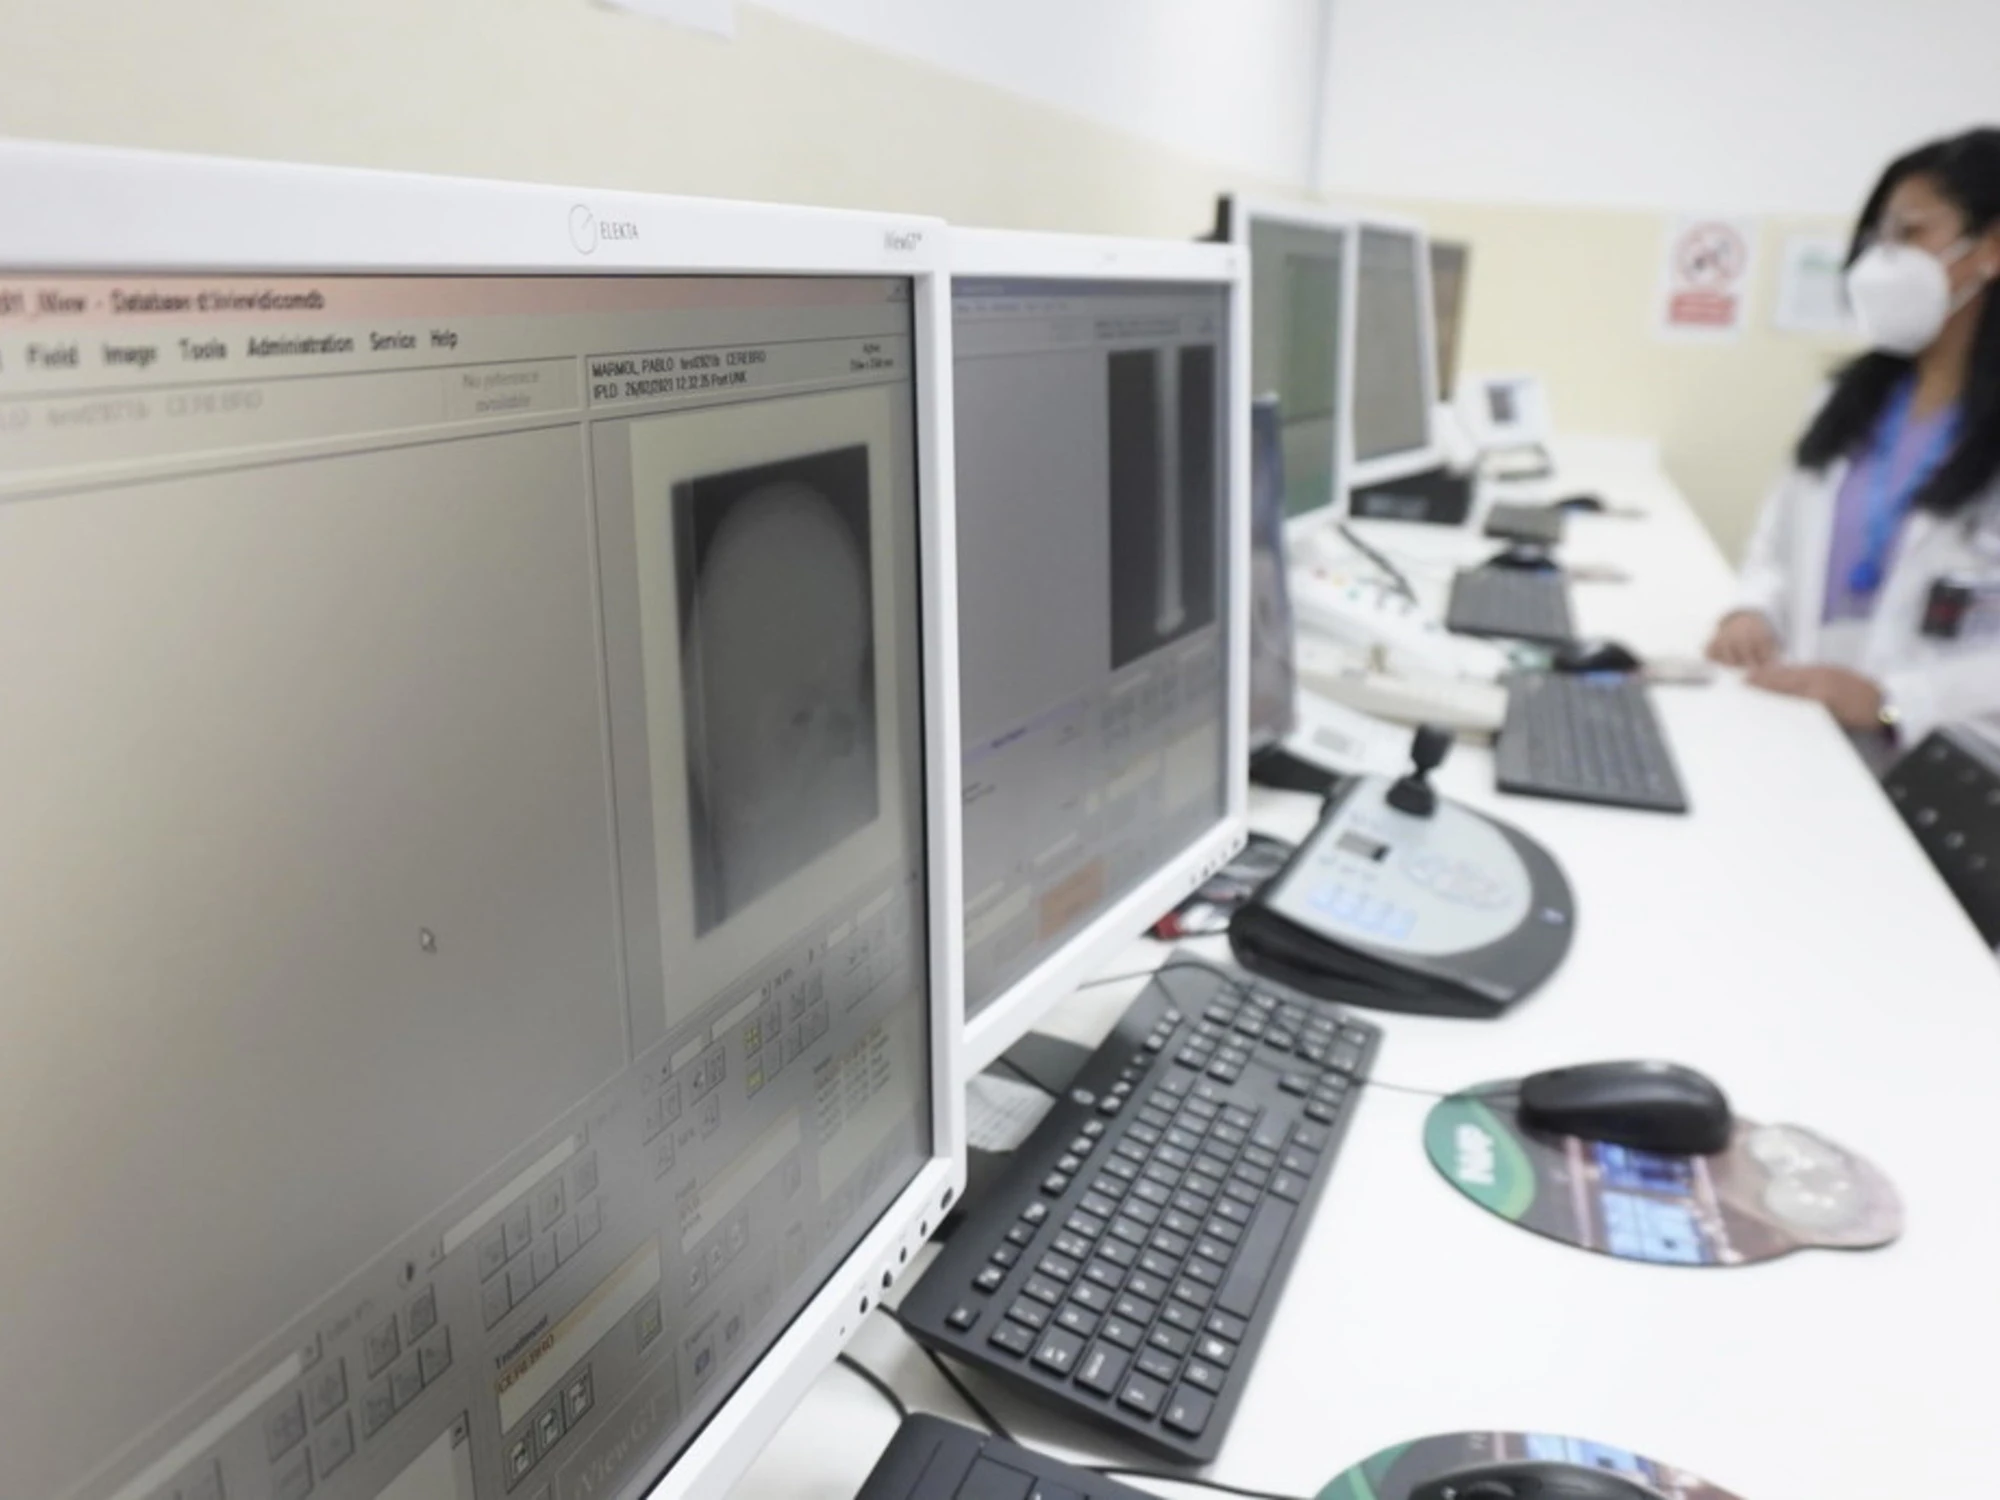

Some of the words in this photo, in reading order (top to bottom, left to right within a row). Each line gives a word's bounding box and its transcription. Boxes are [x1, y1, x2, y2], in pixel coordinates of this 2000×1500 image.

[599, 219, 640, 241] ELEKTA
[26, 343, 79, 369] Field
[104, 343, 158, 370] Image
[179, 337, 228, 361] Tools
[247, 334, 354, 357] Administration
[370, 330, 417, 352] Service
[430, 328, 459, 351] Help
[642, 356, 674, 374] PABLO
[726, 350, 767, 366] CEREBRO
